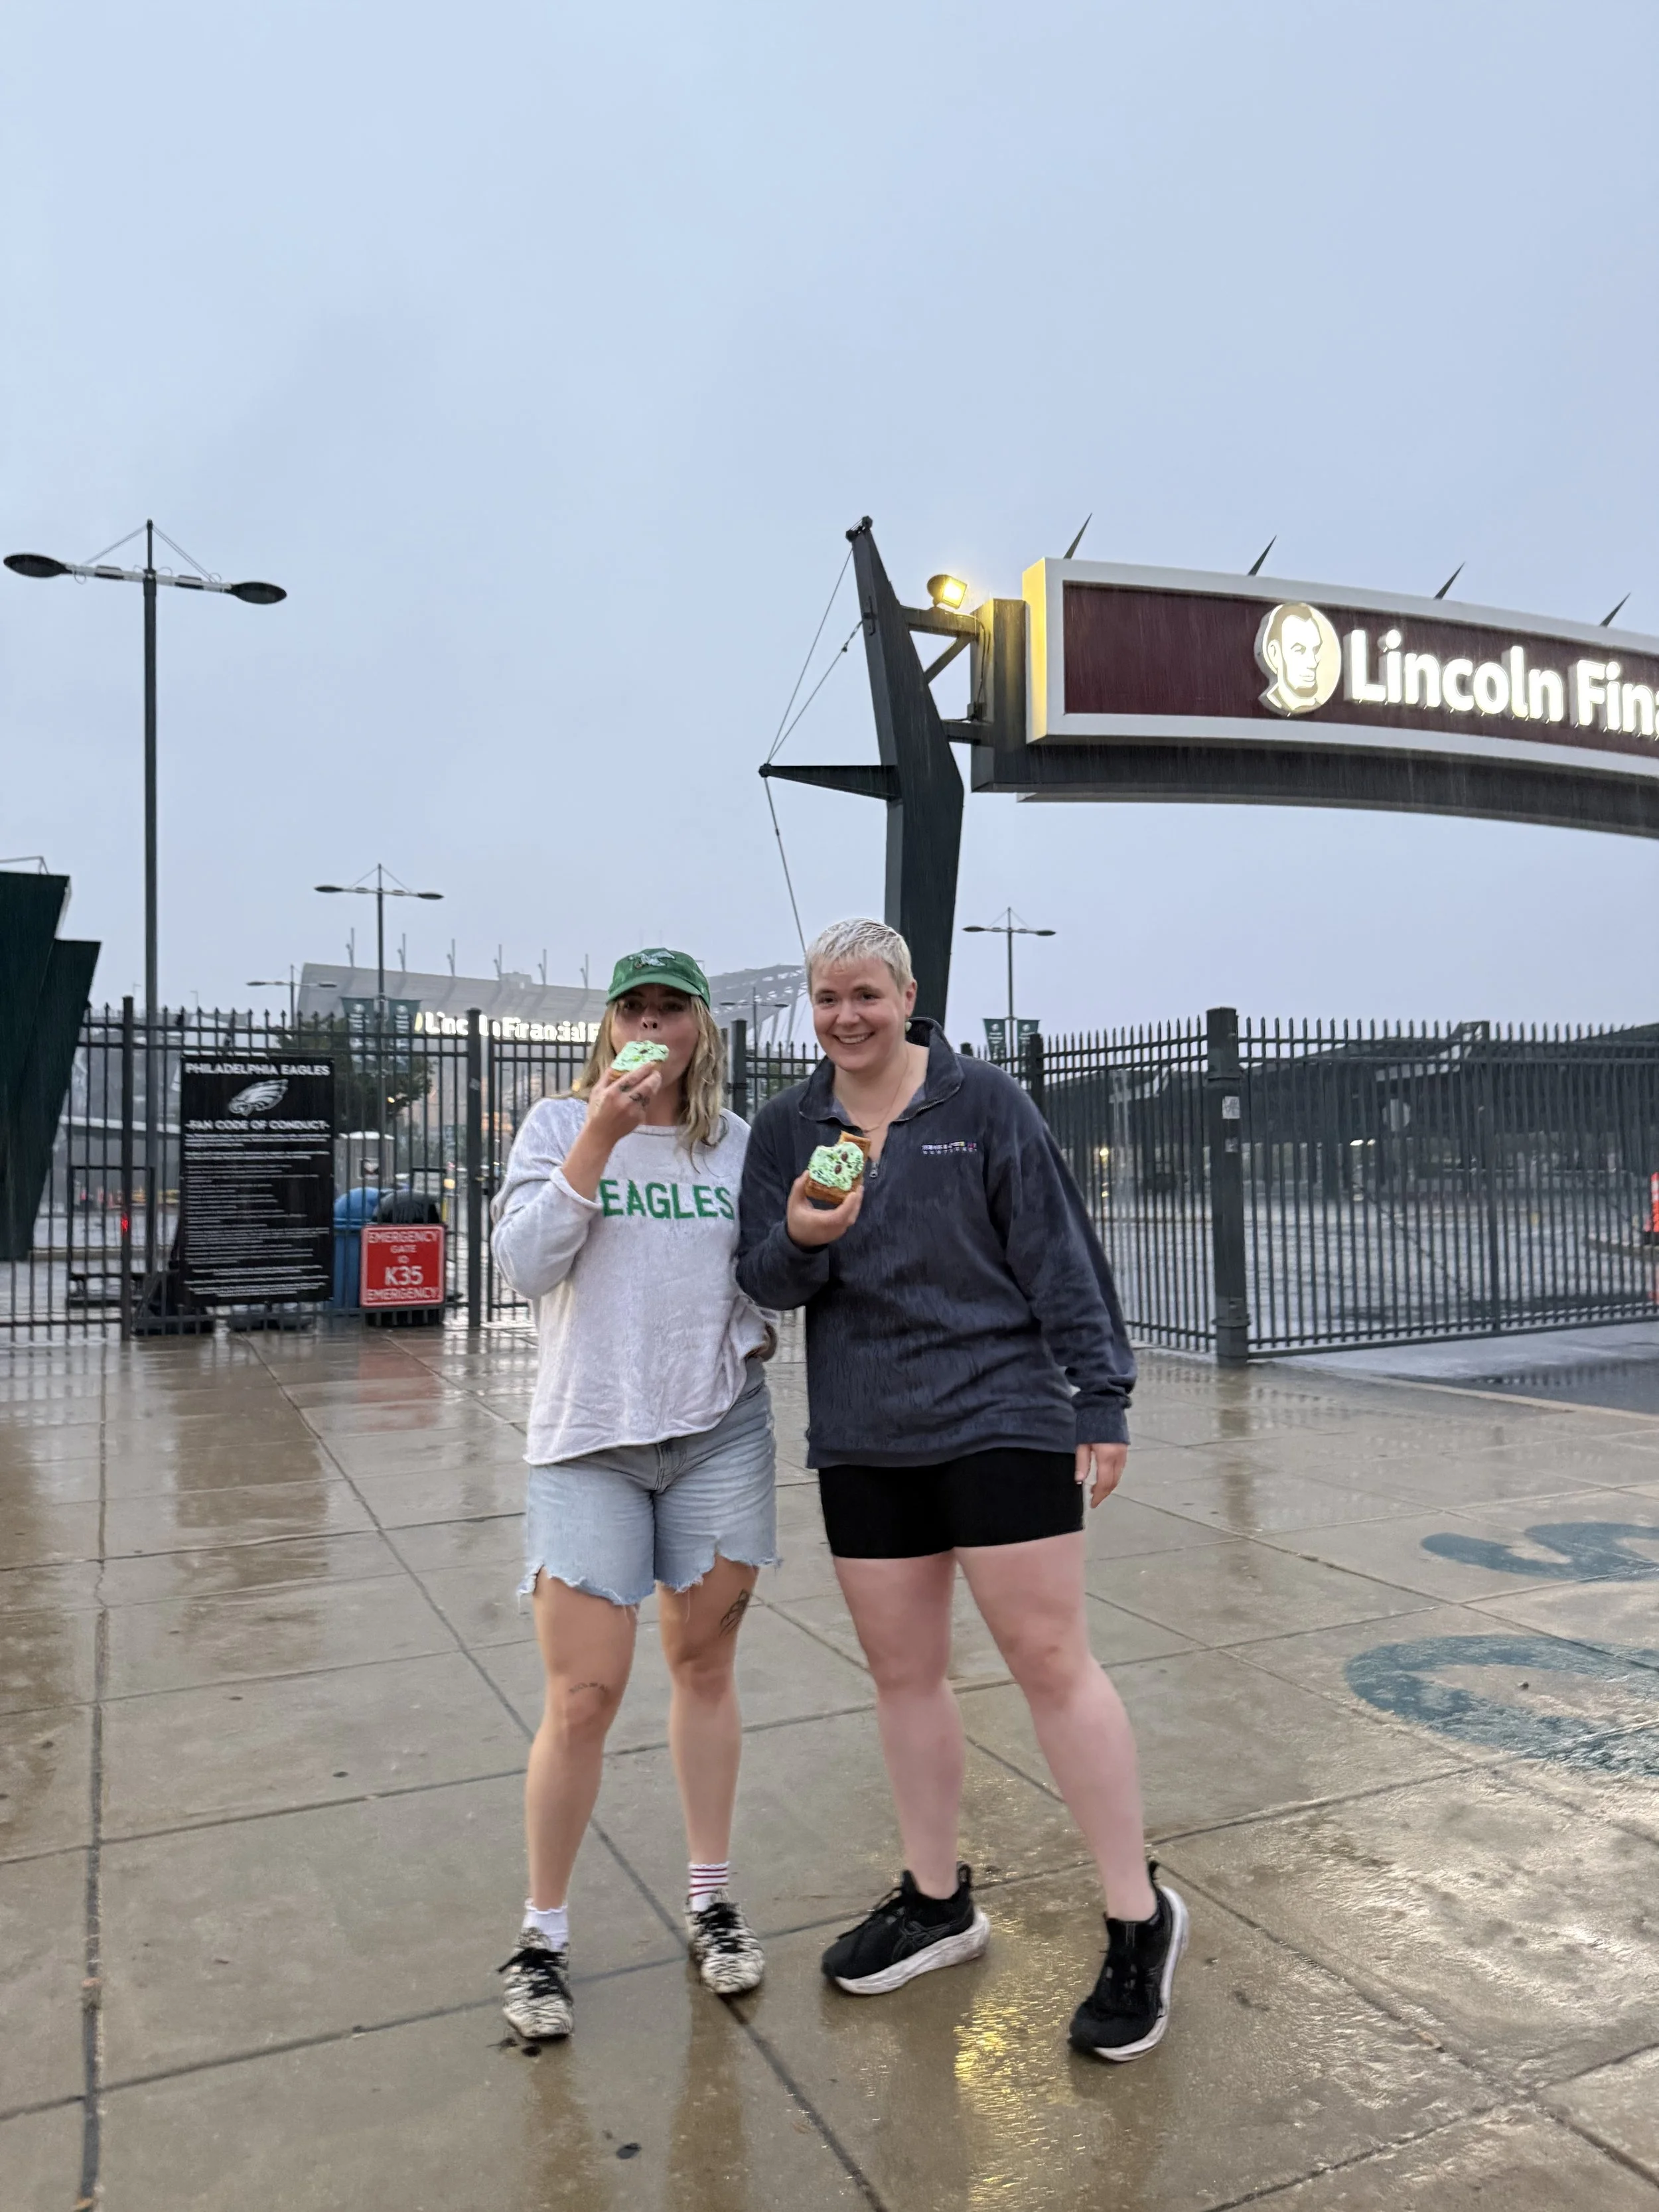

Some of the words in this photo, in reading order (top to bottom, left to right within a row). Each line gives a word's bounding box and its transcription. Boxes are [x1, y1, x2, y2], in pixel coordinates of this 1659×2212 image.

[1347, 628, 1563, 722] Lincoln
[1574, 659, 1659, 738] Fin
[184, 1063, 279, 1075] PHILADELPHIA
[280, 1065, 330, 1076] EAGLES
[214, 1120, 249, 1130] CODE
[250, 1120, 267, 1130] OF
[599, 1179, 735, 1220] EAGLES
[368, 1230, 438, 1244] EMERGENCY
[390, 1244, 417, 1254] GATE
[384, 1266, 424, 1286] K35
[367, 1287, 439, 1301] EMERGENCY
